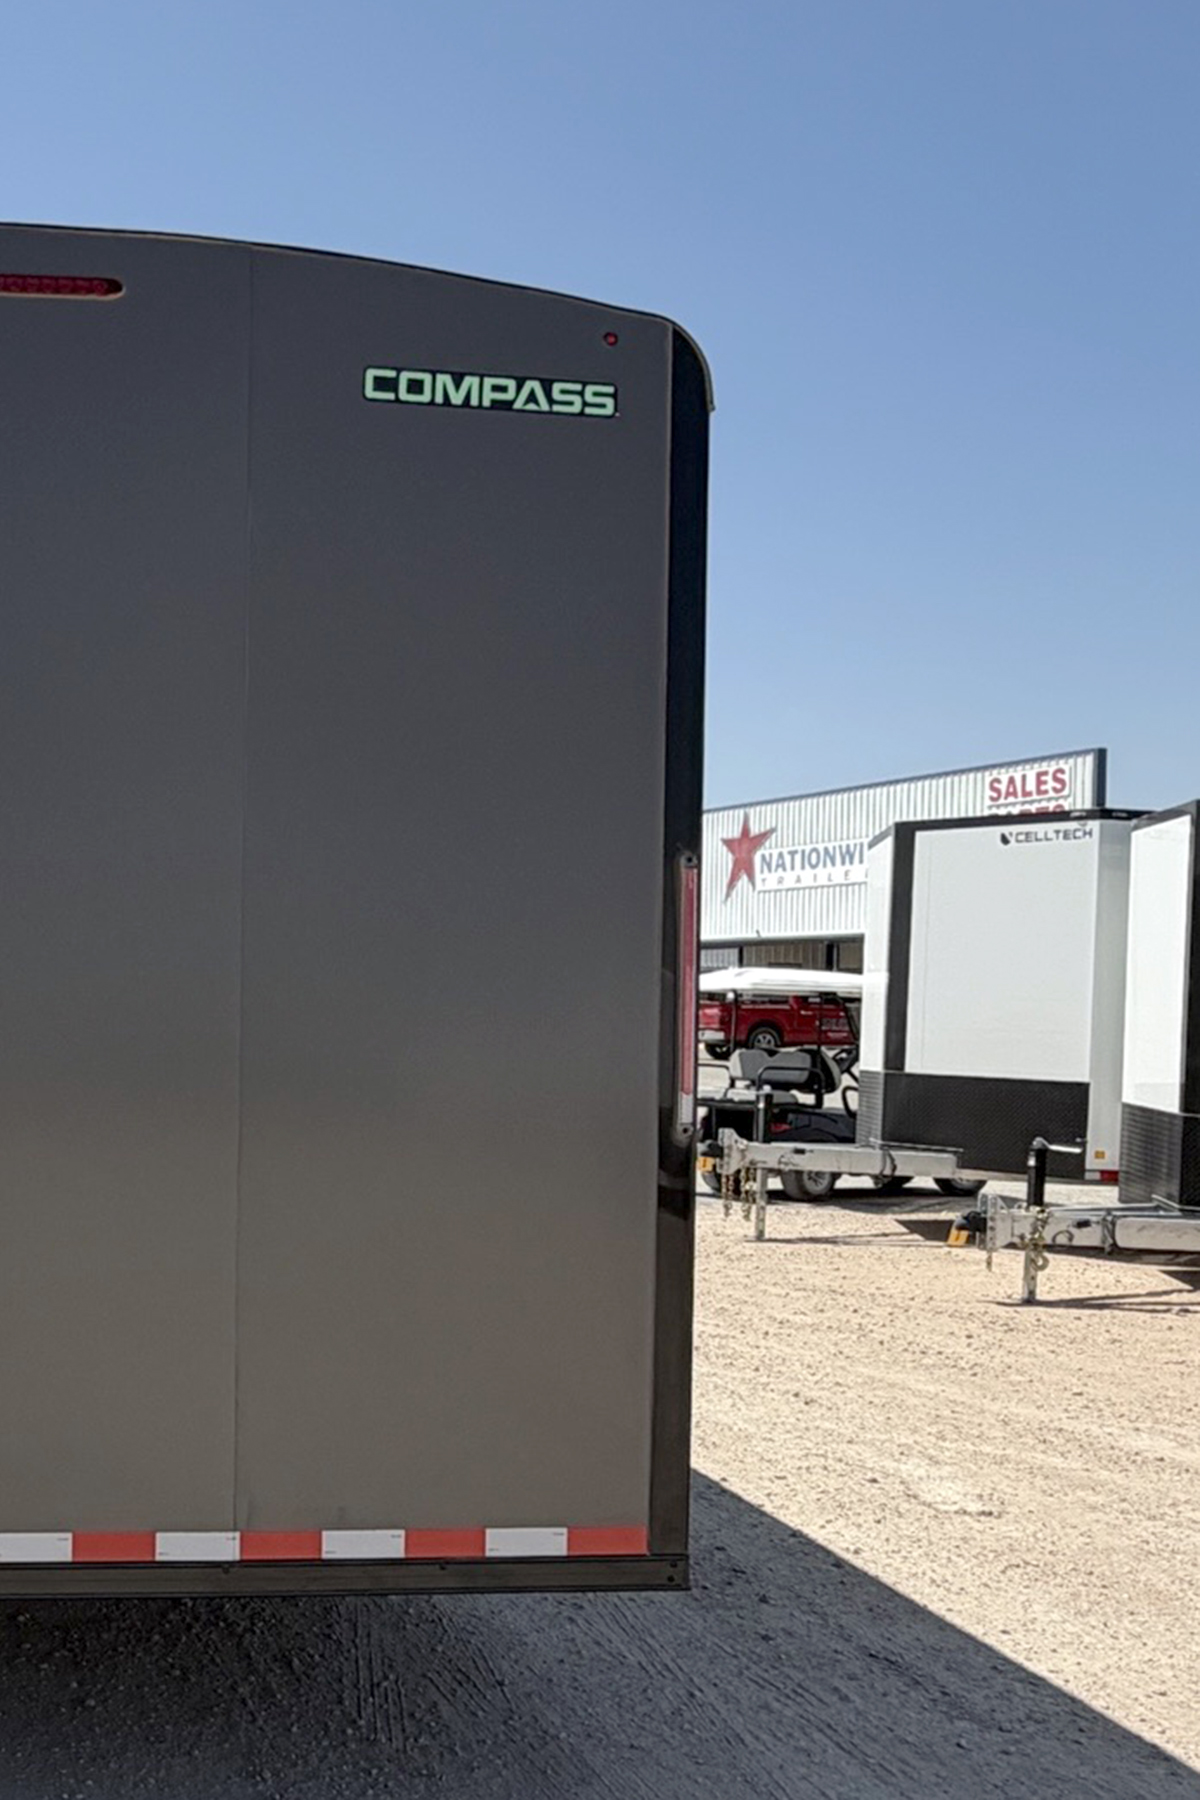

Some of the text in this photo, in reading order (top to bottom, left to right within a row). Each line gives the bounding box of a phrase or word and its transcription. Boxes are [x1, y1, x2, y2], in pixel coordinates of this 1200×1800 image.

[364, 367, 616, 417] COMPASS
[988, 767, 1067, 803] SALES
[1014, 828, 1093, 844] CELLTECH
[761, 868, 869, 887] TRAILE
